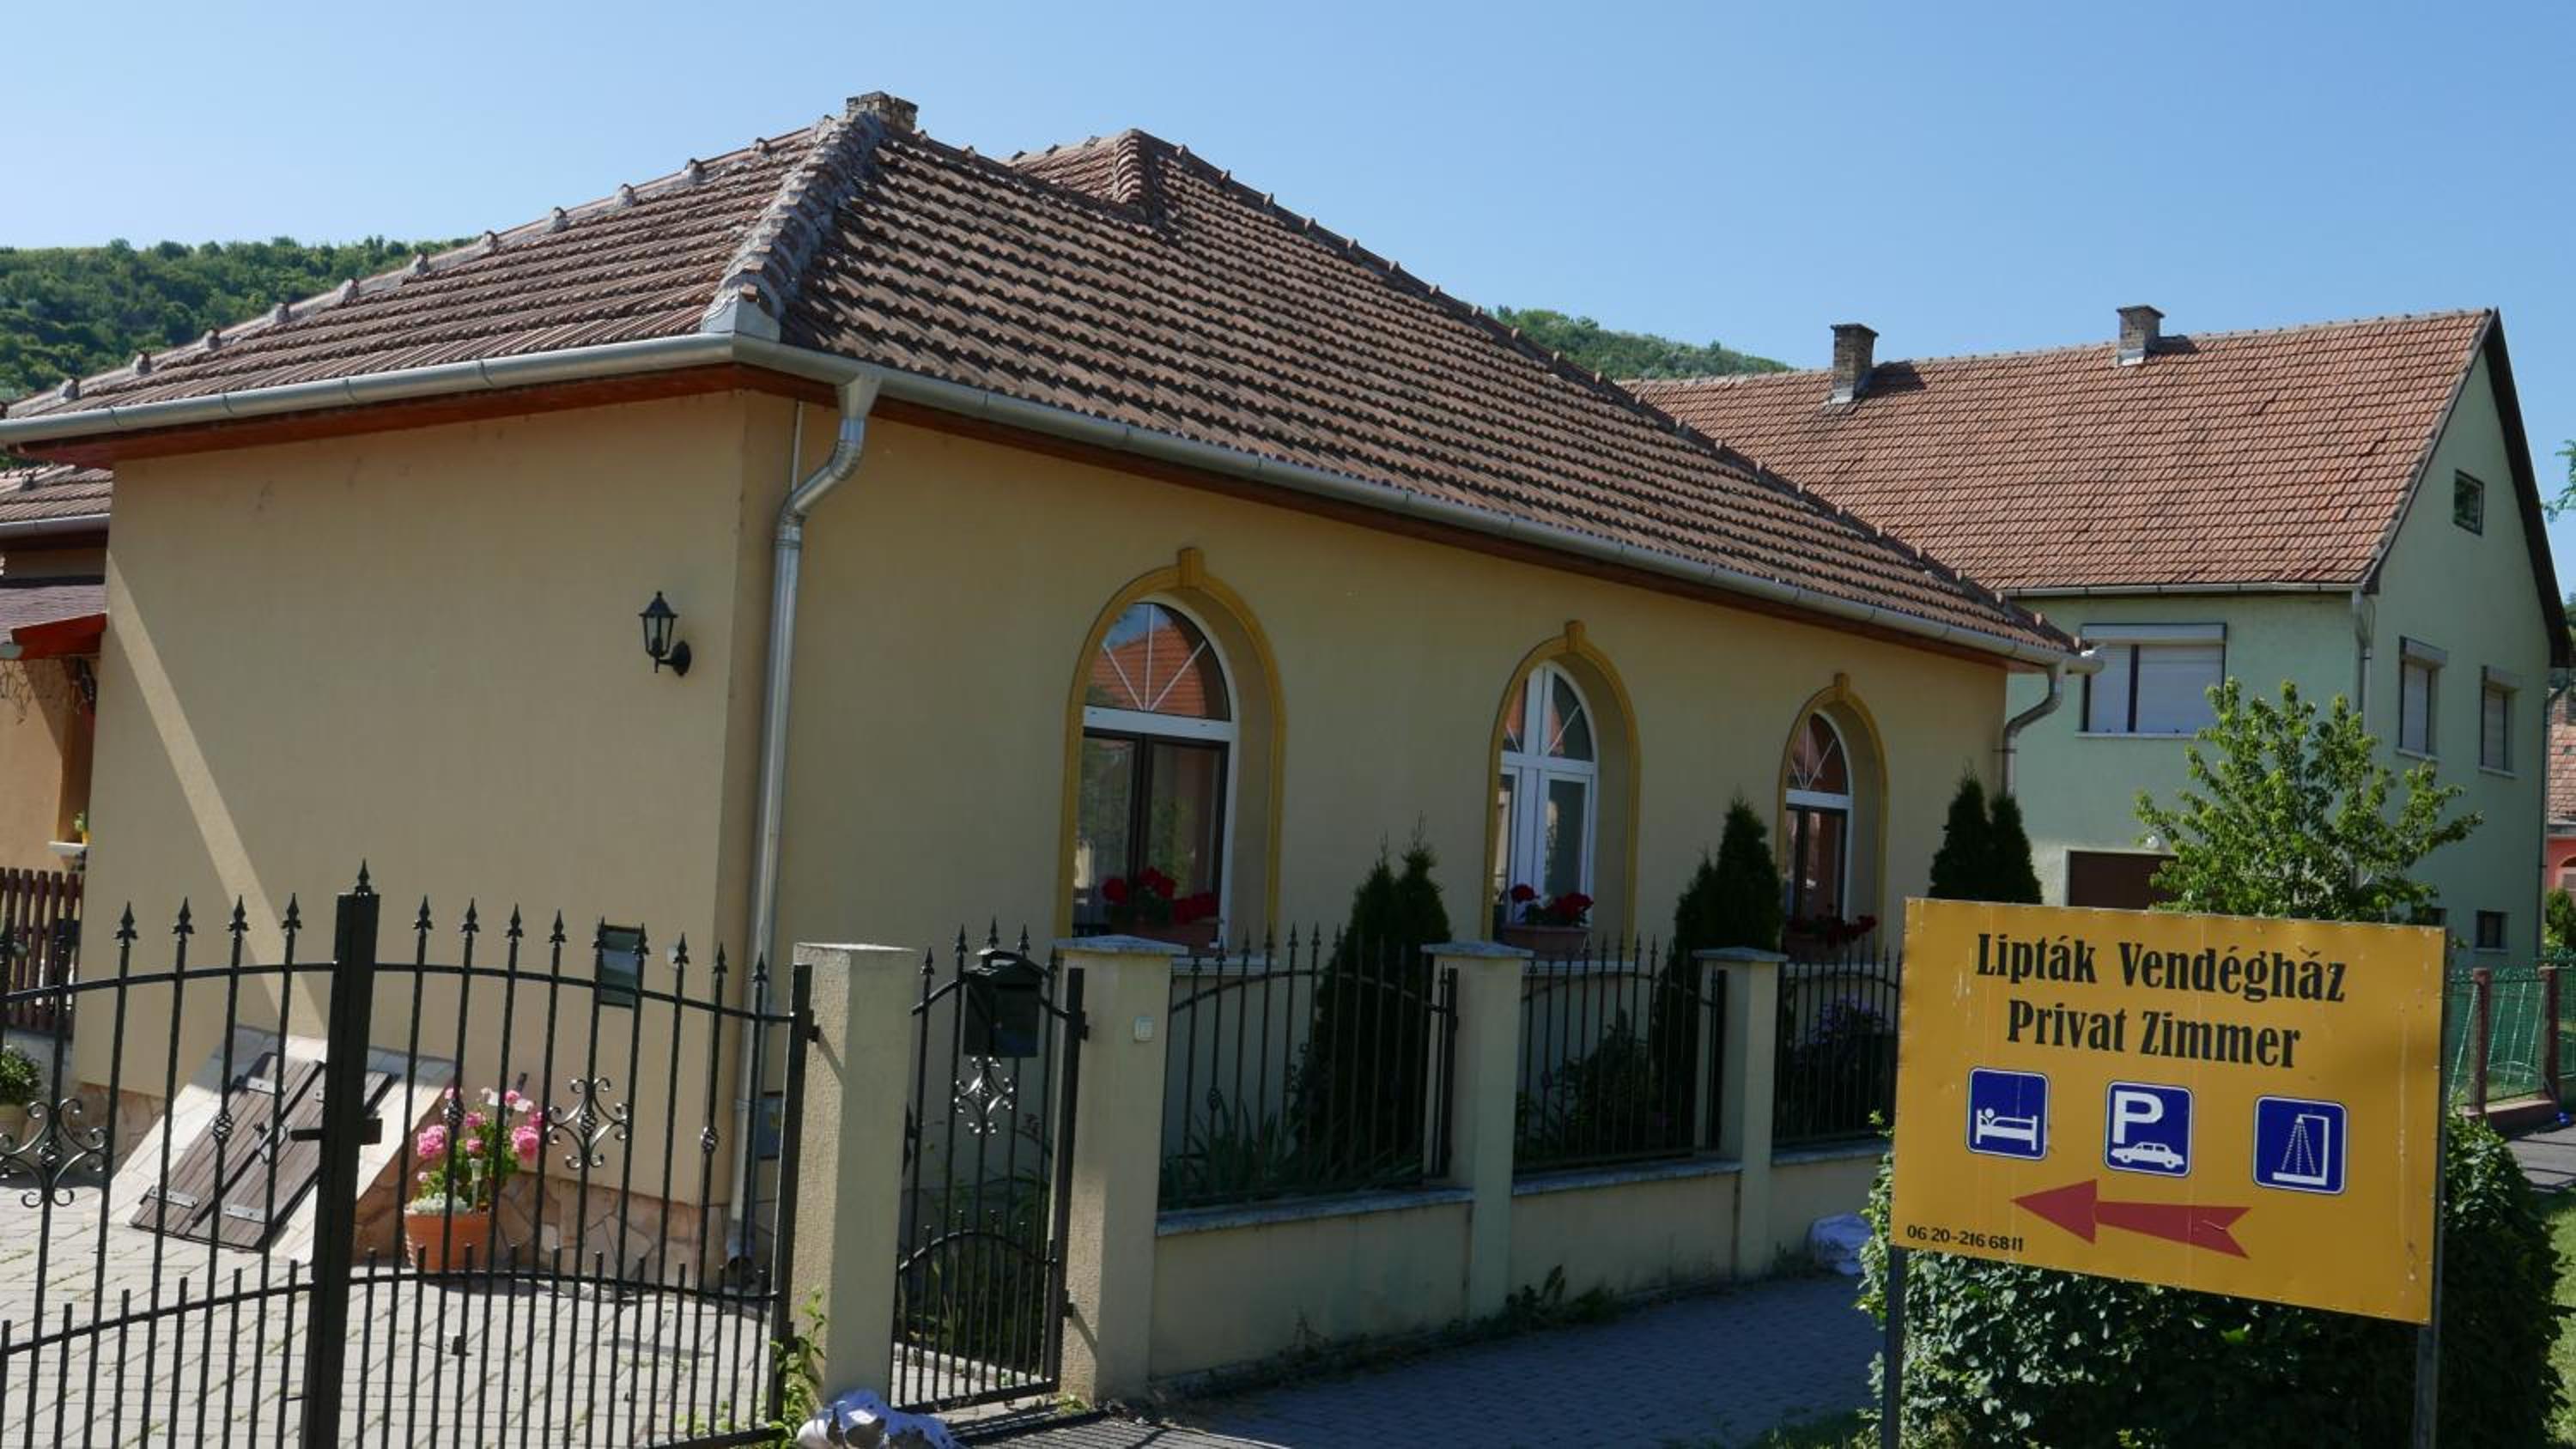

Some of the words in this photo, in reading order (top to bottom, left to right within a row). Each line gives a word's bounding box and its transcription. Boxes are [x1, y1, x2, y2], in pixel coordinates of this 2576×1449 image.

[1977, 933, 2097, 985] Lipták
[2118, 942, 2347, 1003] Vendégház
[2007, 999, 2128, 1053] Privat
[2141, 1009, 2302, 1069] Zimmer
[2113, 1090, 2164, 1144] P
[1906, 1225, 1928, 1240] 06
